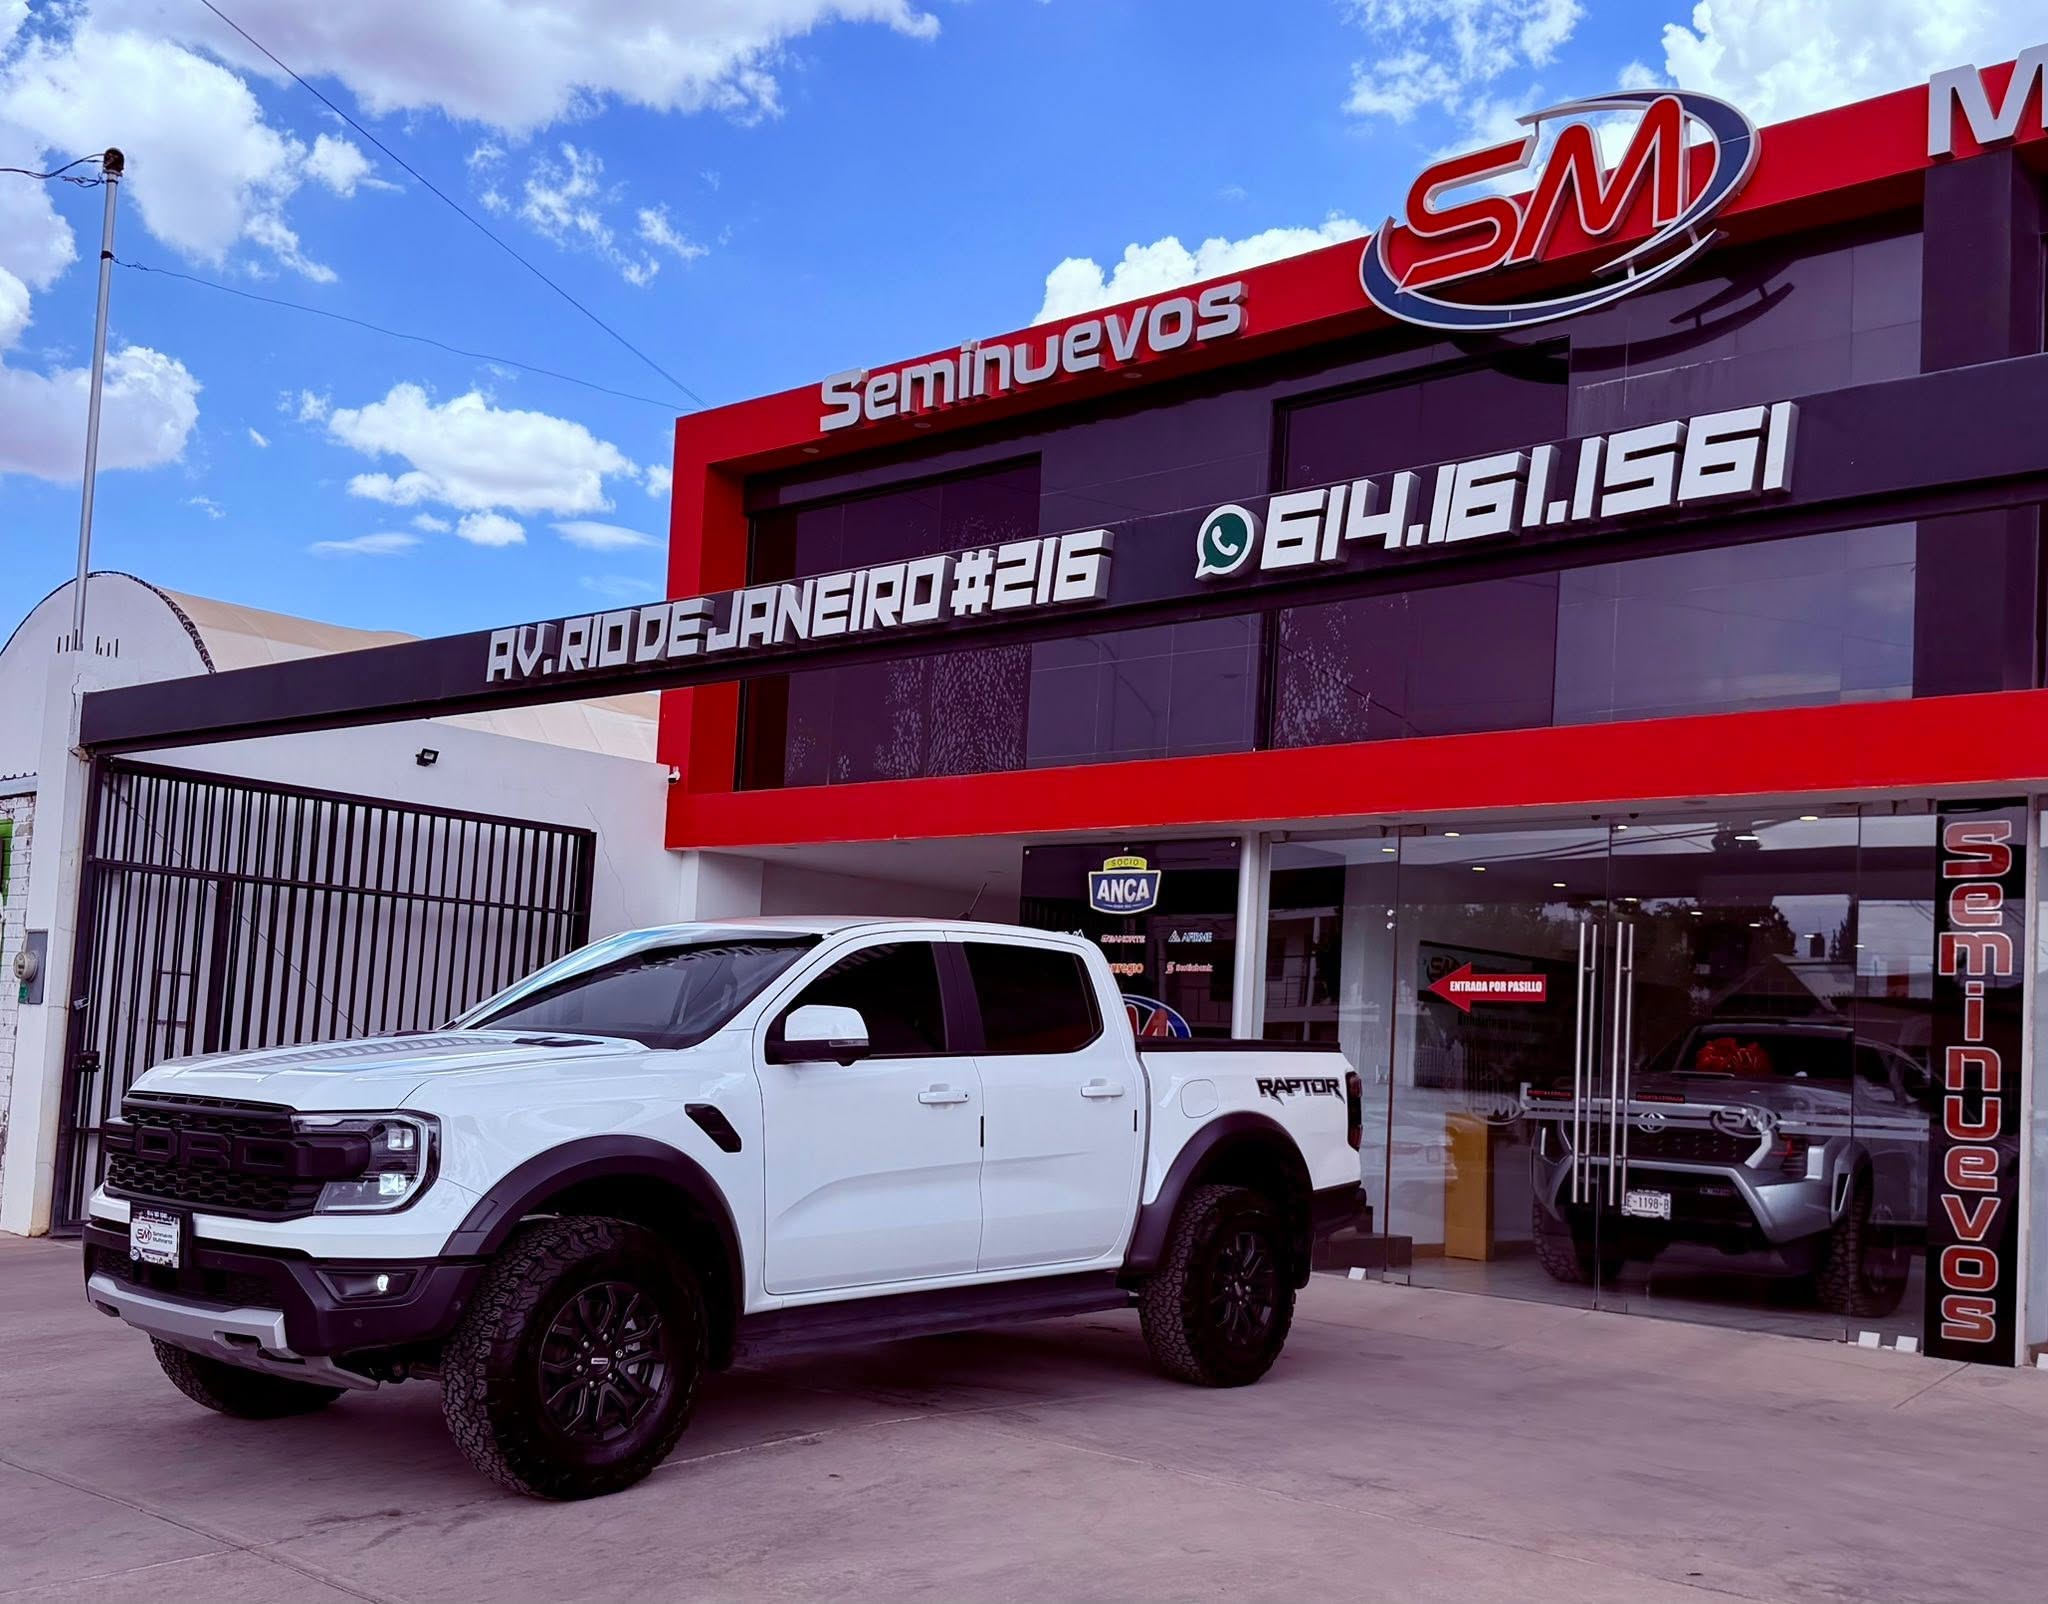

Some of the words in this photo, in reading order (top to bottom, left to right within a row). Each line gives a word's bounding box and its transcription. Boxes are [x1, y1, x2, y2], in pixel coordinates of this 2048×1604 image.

[1395, 92, 1690, 293] SM
[820, 280, 1248, 432] Seminuevos
[1260, 401, 1795, 570] 614.161.1561
[635, 597, 715, 663] DE
[706, 556, 955, 652] JANEIRO
[950, 529, 1114, 616] #216
[1097, 878, 1150, 903] ANCA
[1111, 858, 1140, 867] SOCIO
[1450, 980, 1487, 992] ENTRADA
[1489, 981, 1507, 992] POR
[1508, 981, 1543, 993] PASILLO
[1255, 1077, 1346, 1105] RAPTOR
[1939, 820, 2012, 1343] Seminuevos
